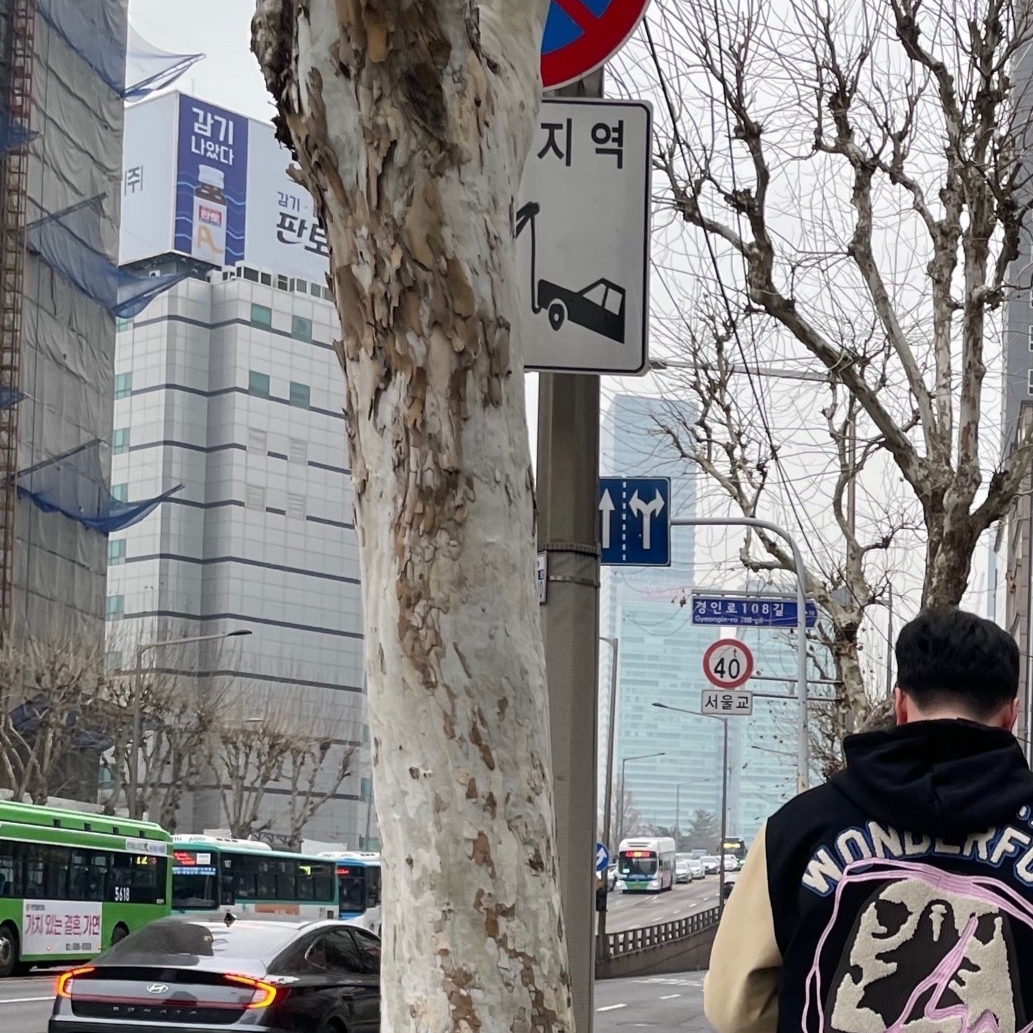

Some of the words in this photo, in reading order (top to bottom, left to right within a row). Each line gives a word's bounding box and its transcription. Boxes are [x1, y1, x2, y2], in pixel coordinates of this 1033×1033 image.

[192, 107, 234, 145] 감기
[191, 136, 234, 165] 나았다
[537, 118, 624, 169] 지역
[277, 191, 300, 212] 감기
[695, 615, 738, 624] Gyeongin-ro
[713, 657, 740, 679] 40
[705, 694, 749, 710] 서울교
[114, 886, 130, 901] 5618
[25, 914, 43, 935] 가치
[45, 914, 62, 935] 있는
[84, 914, 100, 935] 가연
